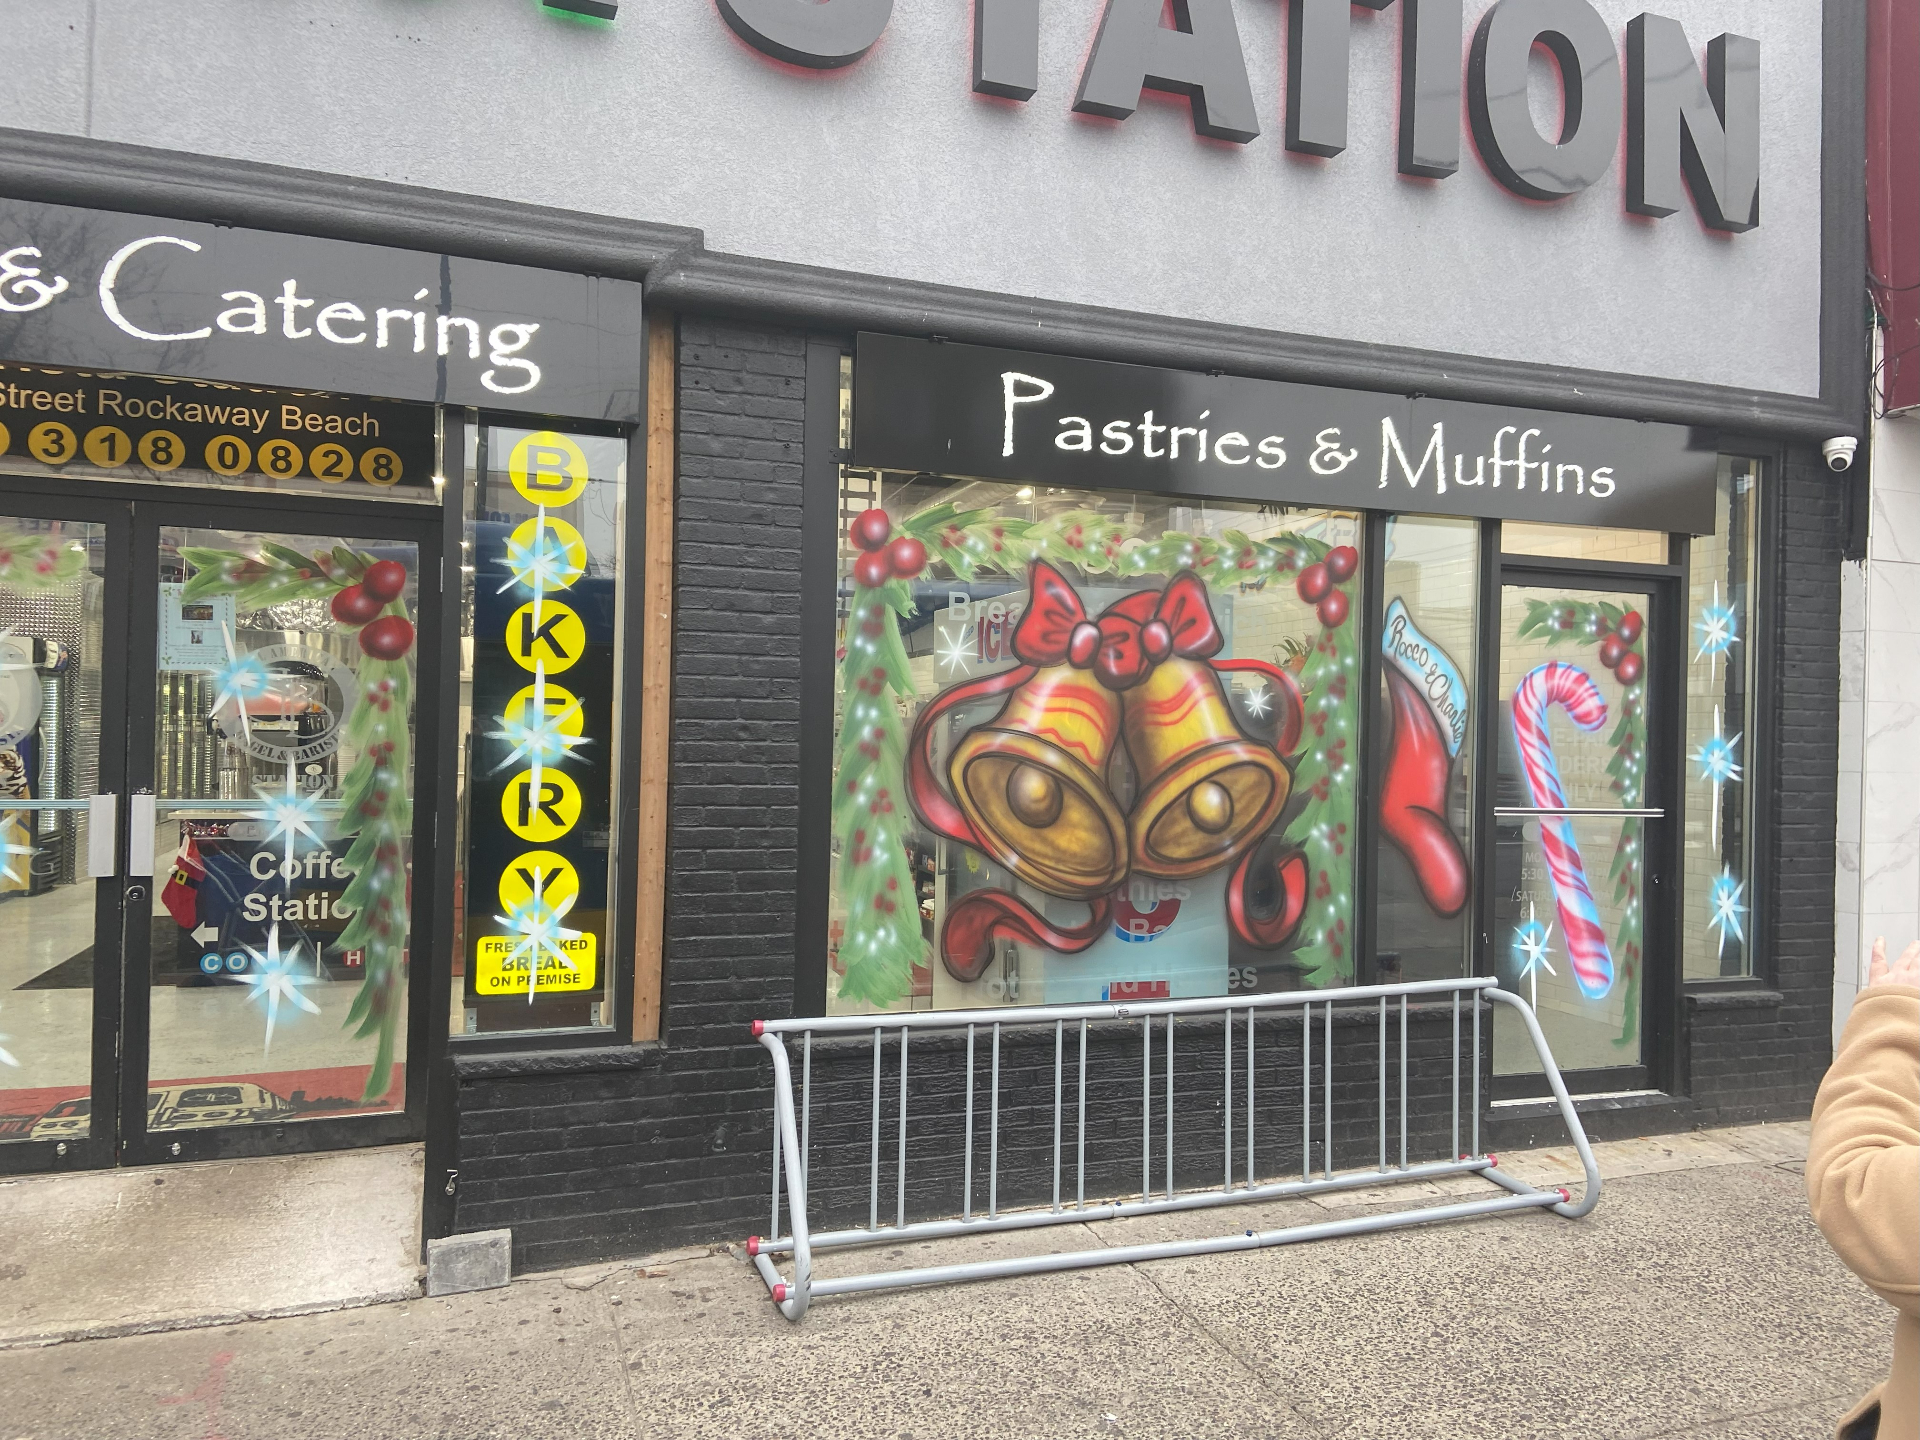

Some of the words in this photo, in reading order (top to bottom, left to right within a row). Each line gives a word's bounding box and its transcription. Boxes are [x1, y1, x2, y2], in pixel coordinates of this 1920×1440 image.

[0, 245, 69, 313] &
[99, 235, 541, 395] Catering
[98, 389, 270, 434] Rockaway
[281, 405, 380, 437] Beach
[1000, 371, 1288, 469] Pastries
[1309, 426, 1358, 475] &
[1379, 416, 1616, 498] Muffins
[1388, 614, 1429, 668] Rocco
[1428, 673, 1467, 744] Charlie
[292, 728, 340, 761] BARIST
[251, 774, 337, 792] STAION
[250, 851, 350, 881] Coffe
[242, 892, 352, 922] Statio
[538, 939, 588, 952] BKED
[490, 976, 511, 987] ON
